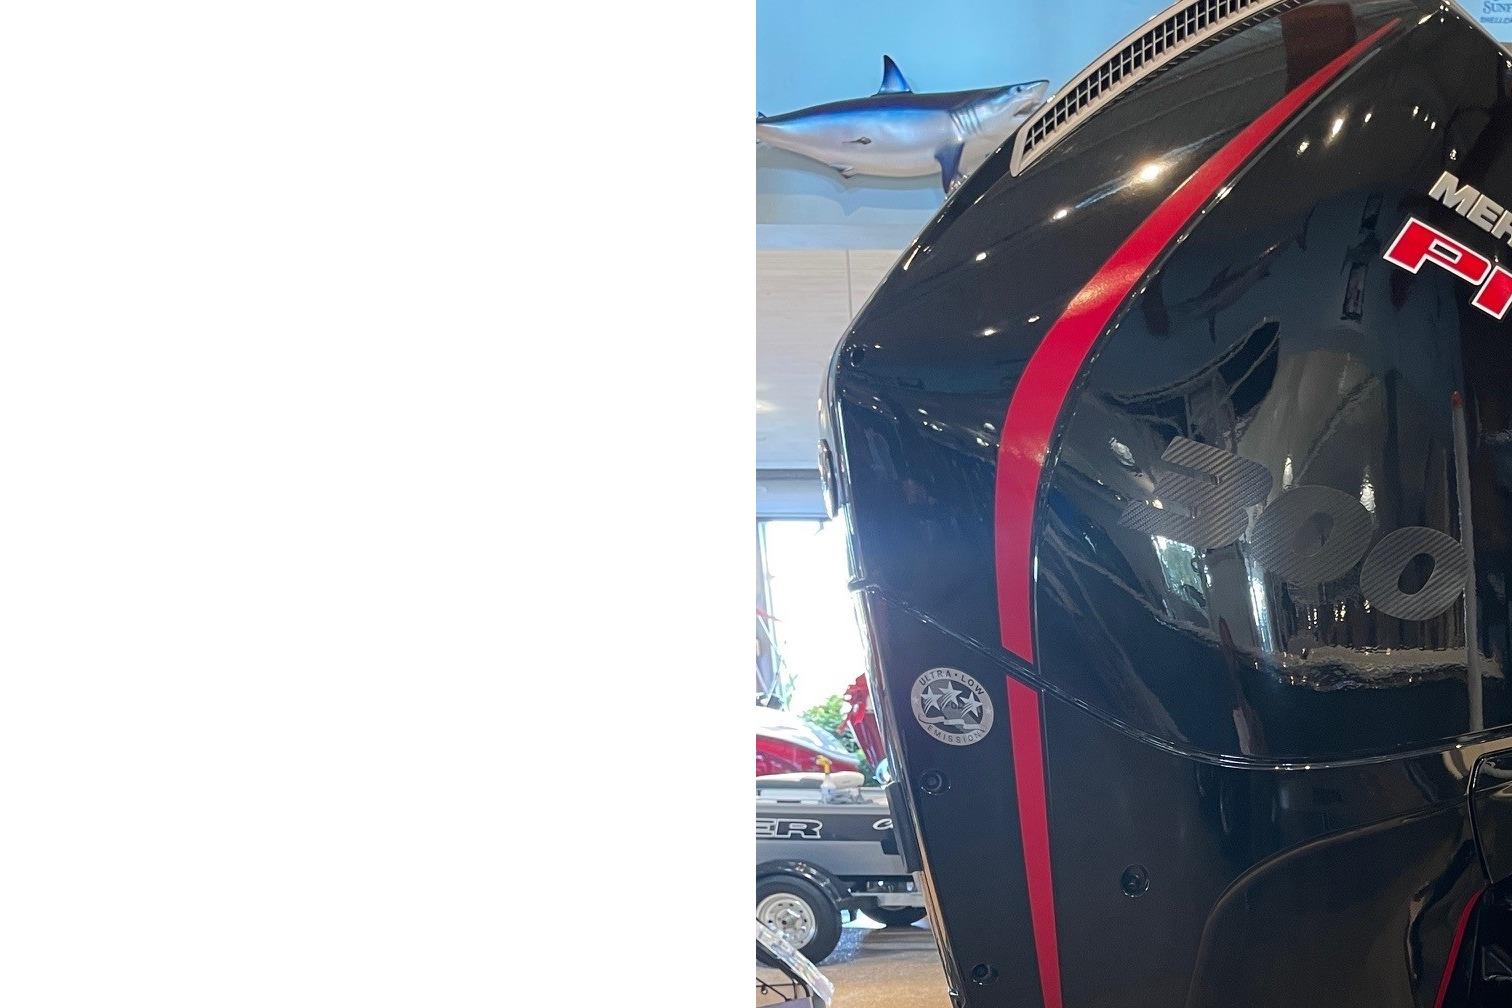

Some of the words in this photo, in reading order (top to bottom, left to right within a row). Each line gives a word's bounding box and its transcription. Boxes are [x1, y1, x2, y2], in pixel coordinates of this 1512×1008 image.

[1119, 436, 1469, 621] 300
[919, 669, 952, 686] ULTRA
[960, 674, 985, 696] LOW
